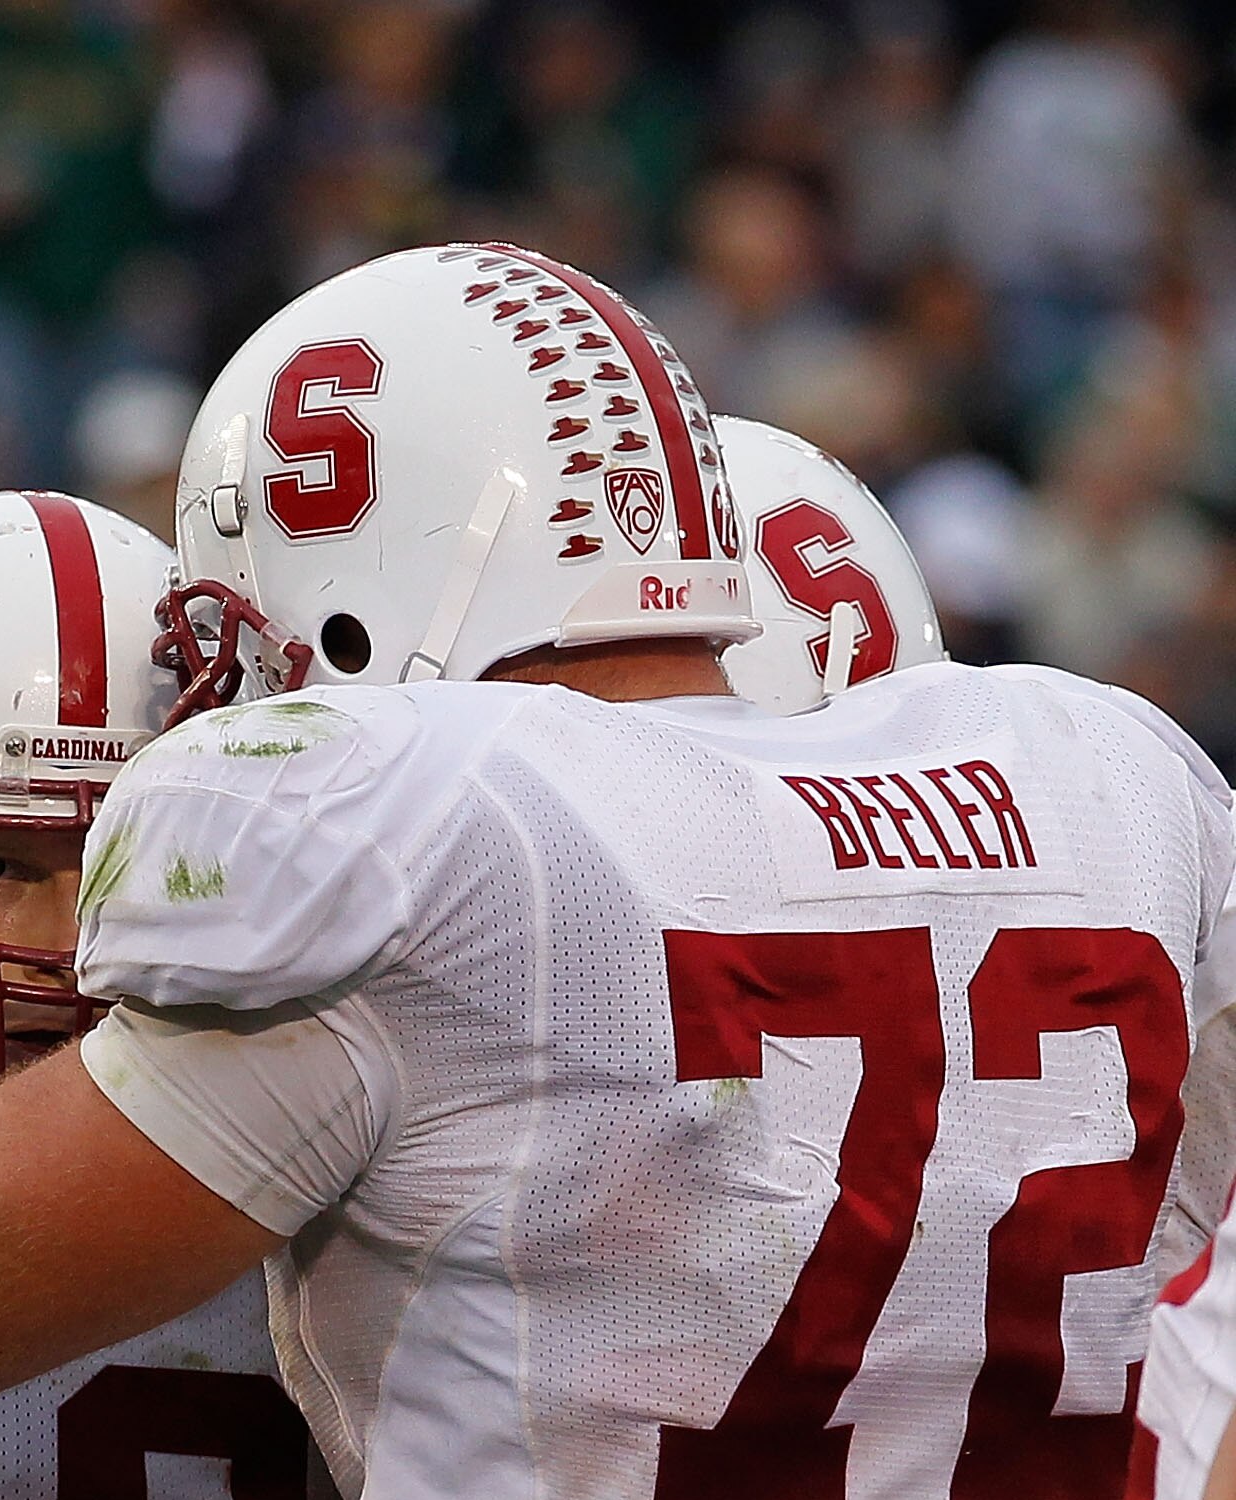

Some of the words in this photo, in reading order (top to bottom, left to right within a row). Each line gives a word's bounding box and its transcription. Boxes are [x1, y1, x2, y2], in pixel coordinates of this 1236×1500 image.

[263, 336, 386, 543] S
[608, 472, 662, 520] PAC
[625, 505, 656, 535] 10
[755, 498, 899, 686] S
[31, 737, 128, 763] CARDINAL
[778, 759, 1038, 871] BEELER
